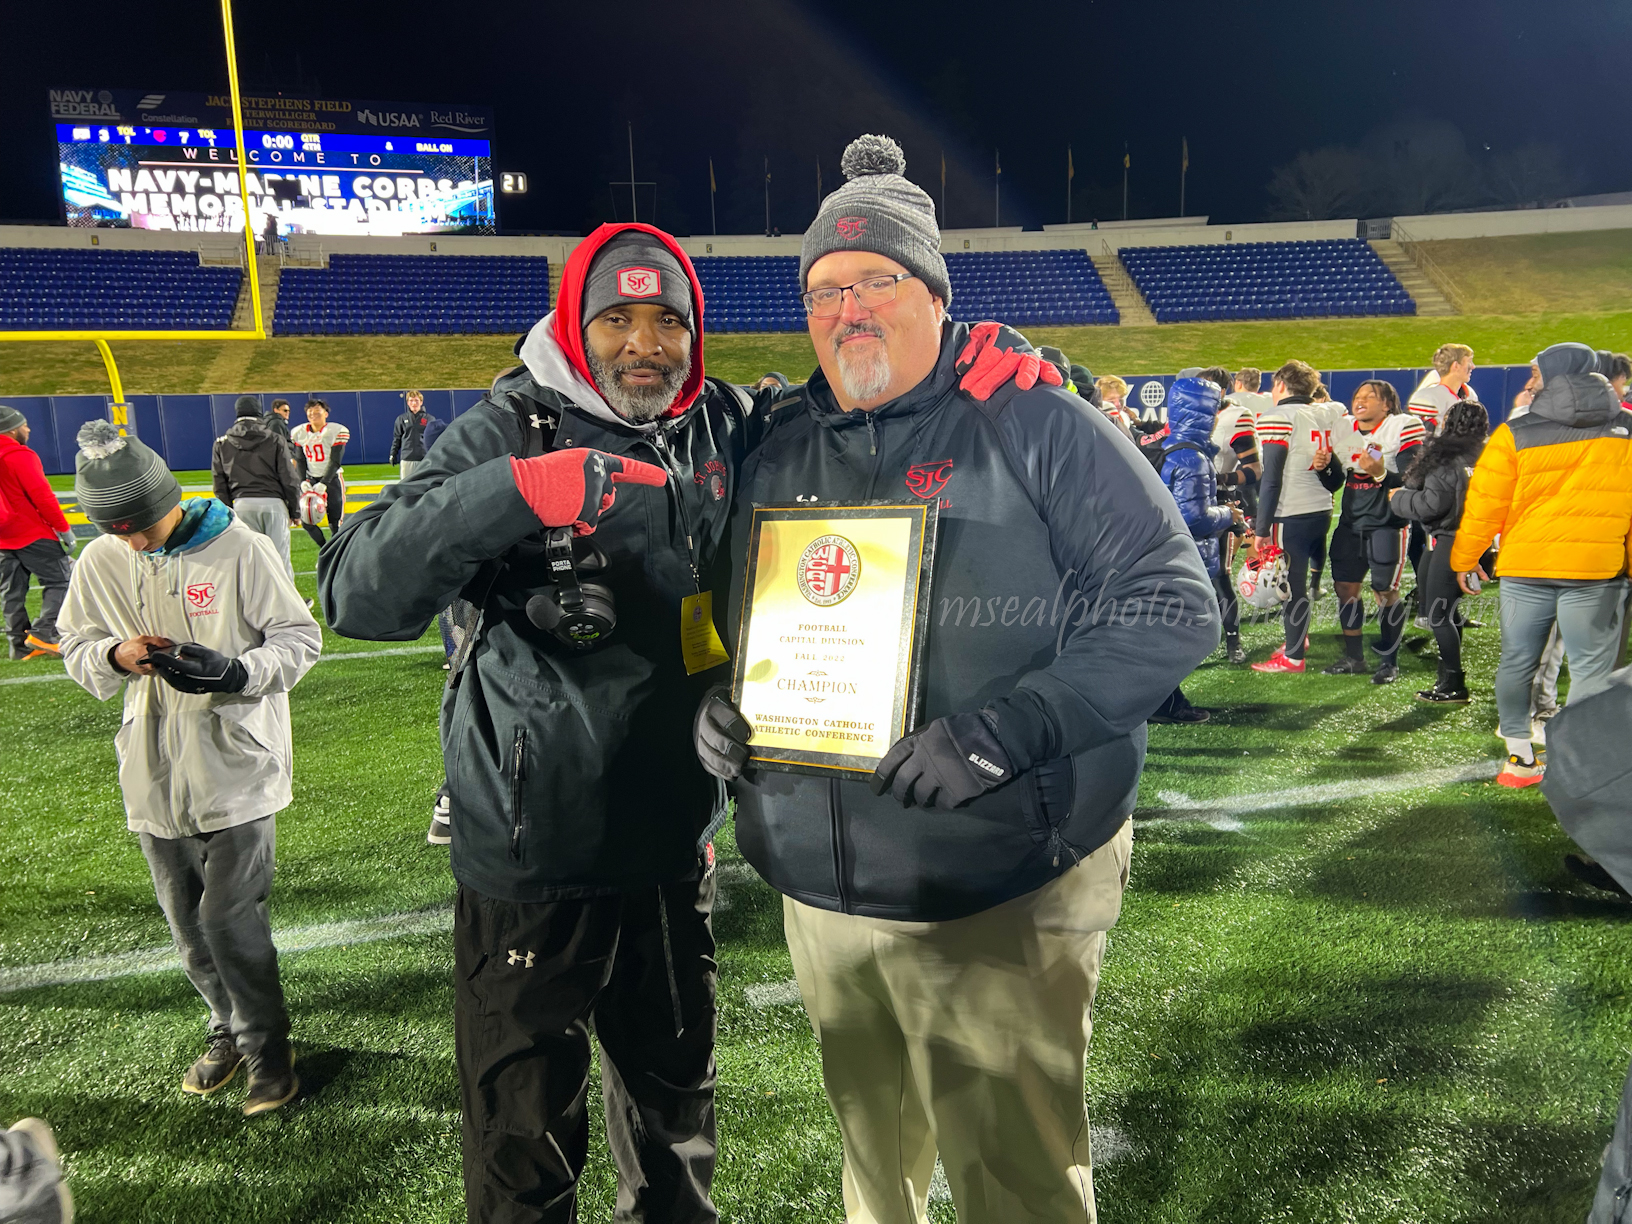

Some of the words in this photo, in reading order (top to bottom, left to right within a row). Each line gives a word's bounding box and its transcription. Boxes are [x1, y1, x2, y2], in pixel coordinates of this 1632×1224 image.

[50, 90, 94, 103] NAVY
[51, 102, 120, 116] FEDERAL
[241, 97, 311, 110] STEPHENS
[314, 101, 351, 112] FIELD
[141, 113, 198, 124] Constellation
[244, 109, 317, 121] TERWILLIGER
[379, 113, 420, 128] USAA
[430, 111, 452, 124] Red
[455, 112, 485, 125] River
[117, 126, 136, 136] TOL
[267, 119, 336, 130] SCOREBOARD
[98, 128, 110, 142] 3
[178, 131, 190, 144] 7
[197, 128, 217, 139] TOL
[301, 133, 320, 143] QTR
[262, 134, 294, 149] 0:00
[302, 142, 322, 151] 4TH
[416, 143, 438, 153] BALL
[439, 143, 453, 153] ON
[183, 147, 325, 164] WELCOME
[351, 153, 381, 165] TO
[107, 167, 341, 198] NAVY-MANE
[503, 174, 524, 191] 21
[627, 275, 651, 290] SJC
[306, 444, 325, 462] 40
[694, 471, 708, 485] ST.
[905, 463, 953, 493] SJC
[186, 586, 216, 604] SJC
[189, 609, 219, 617] FOOTBALL
[798, 624, 848, 633] FOOTBALL
[779, 635, 817, 645] CAPITAL
[821, 637, 866, 646] DIVISION
[795, 653, 817, 661] FALL
[822, 654, 846, 662] 2022
[777, 678, 858, 695] CHAMPION
[755, 713, 820, 726] WASHINGTON
[823, 719, 875, 731] CATHOLIC
[753, 725, 801, 736] ATHLETIC
[805, 729, 875, 743] CONFERENCE
[968, 752, 1005, 777] BLIZZARD
